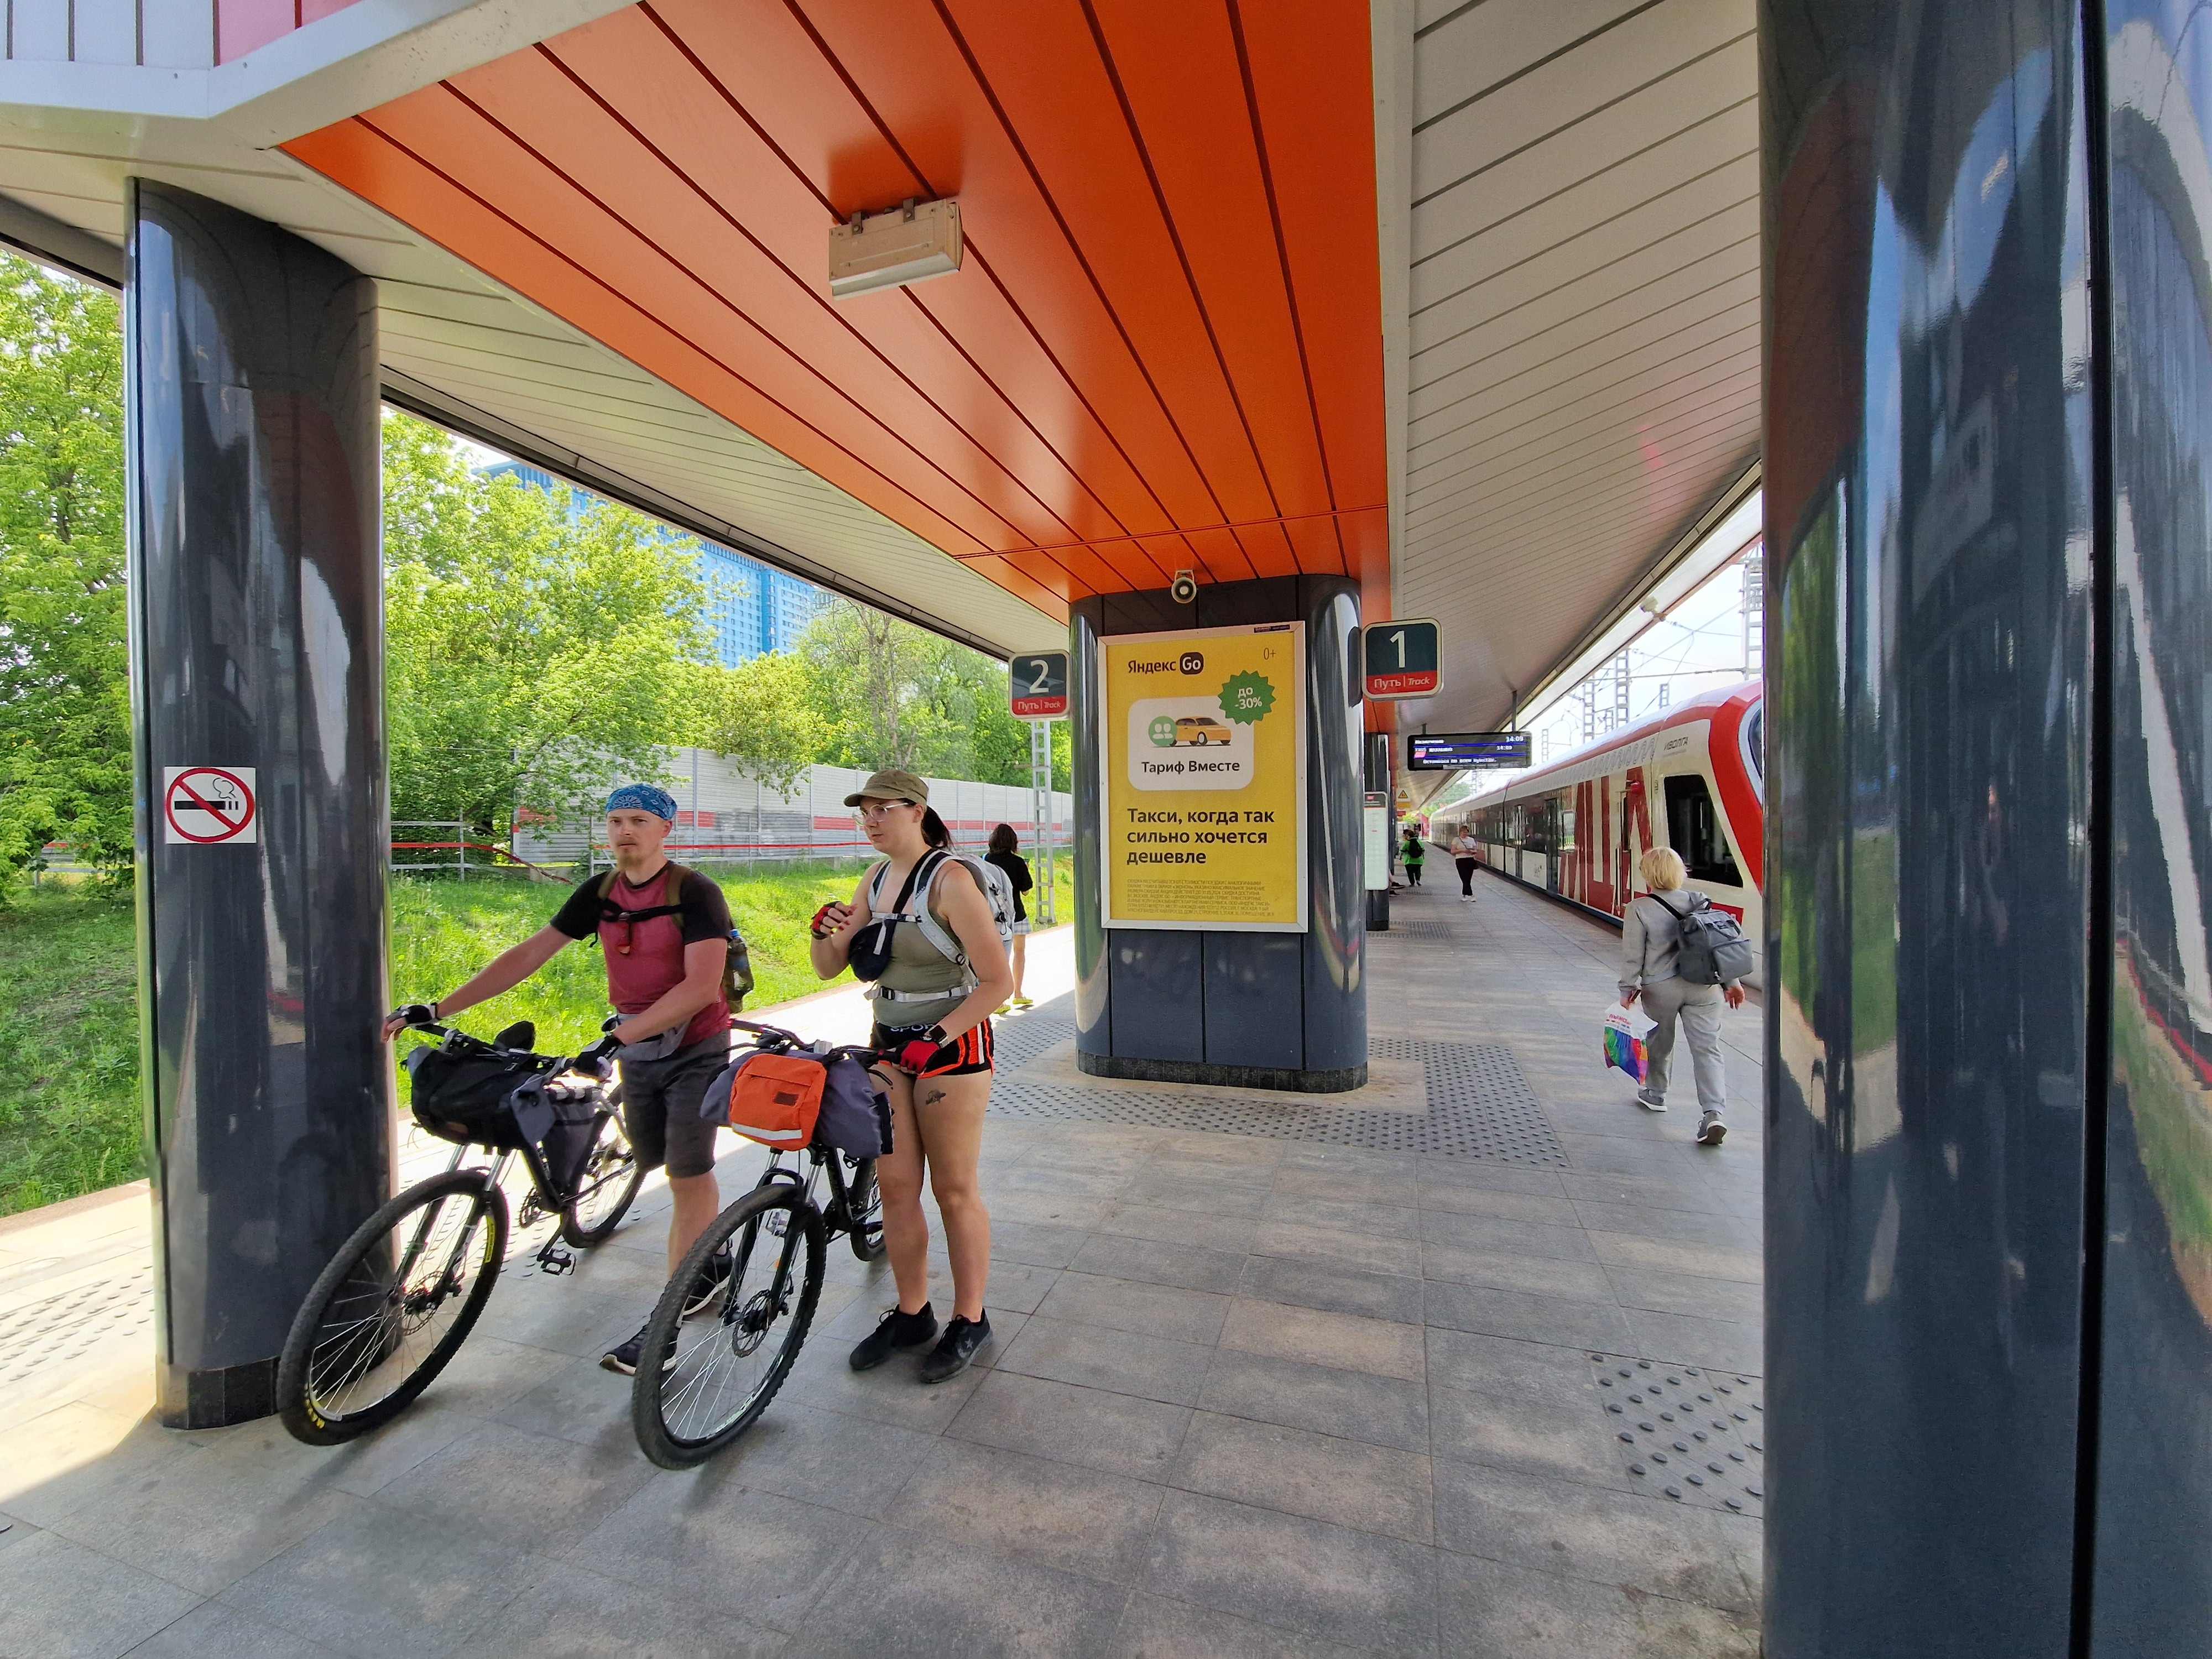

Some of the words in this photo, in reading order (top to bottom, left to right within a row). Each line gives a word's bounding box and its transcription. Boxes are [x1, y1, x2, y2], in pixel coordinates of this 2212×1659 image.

[1263, 648, 1276, 660] 0+
[1390, 630, 1405, 668] 1
[1128, 660, 1176, 674] Яндекс
[1182, 657, 1202, 671] Go
[1029, 659, 1049, 694] 2
[1374, 678, 1401, 690] Путь
[1408, 676, 1431, 686] Track
[1238, 686, 1253, 698] до
[1018, 701, 1039, 712] Путь
[1235, 696, 1262, 709] -30%
[1141, 761, 1185, 774] Тариф
[1188, 760, 1240, 772] Вместе
[1127, 808, 1182, 825] Такси,
[1188, 811, 1238, 826] когда
[1244, 811, 1274, 823] так
[1127, 832, 1190, 843] сильно
[1194, 833, 1267, 844] хочется
[1127, 851, 1206, 865] дешевле
